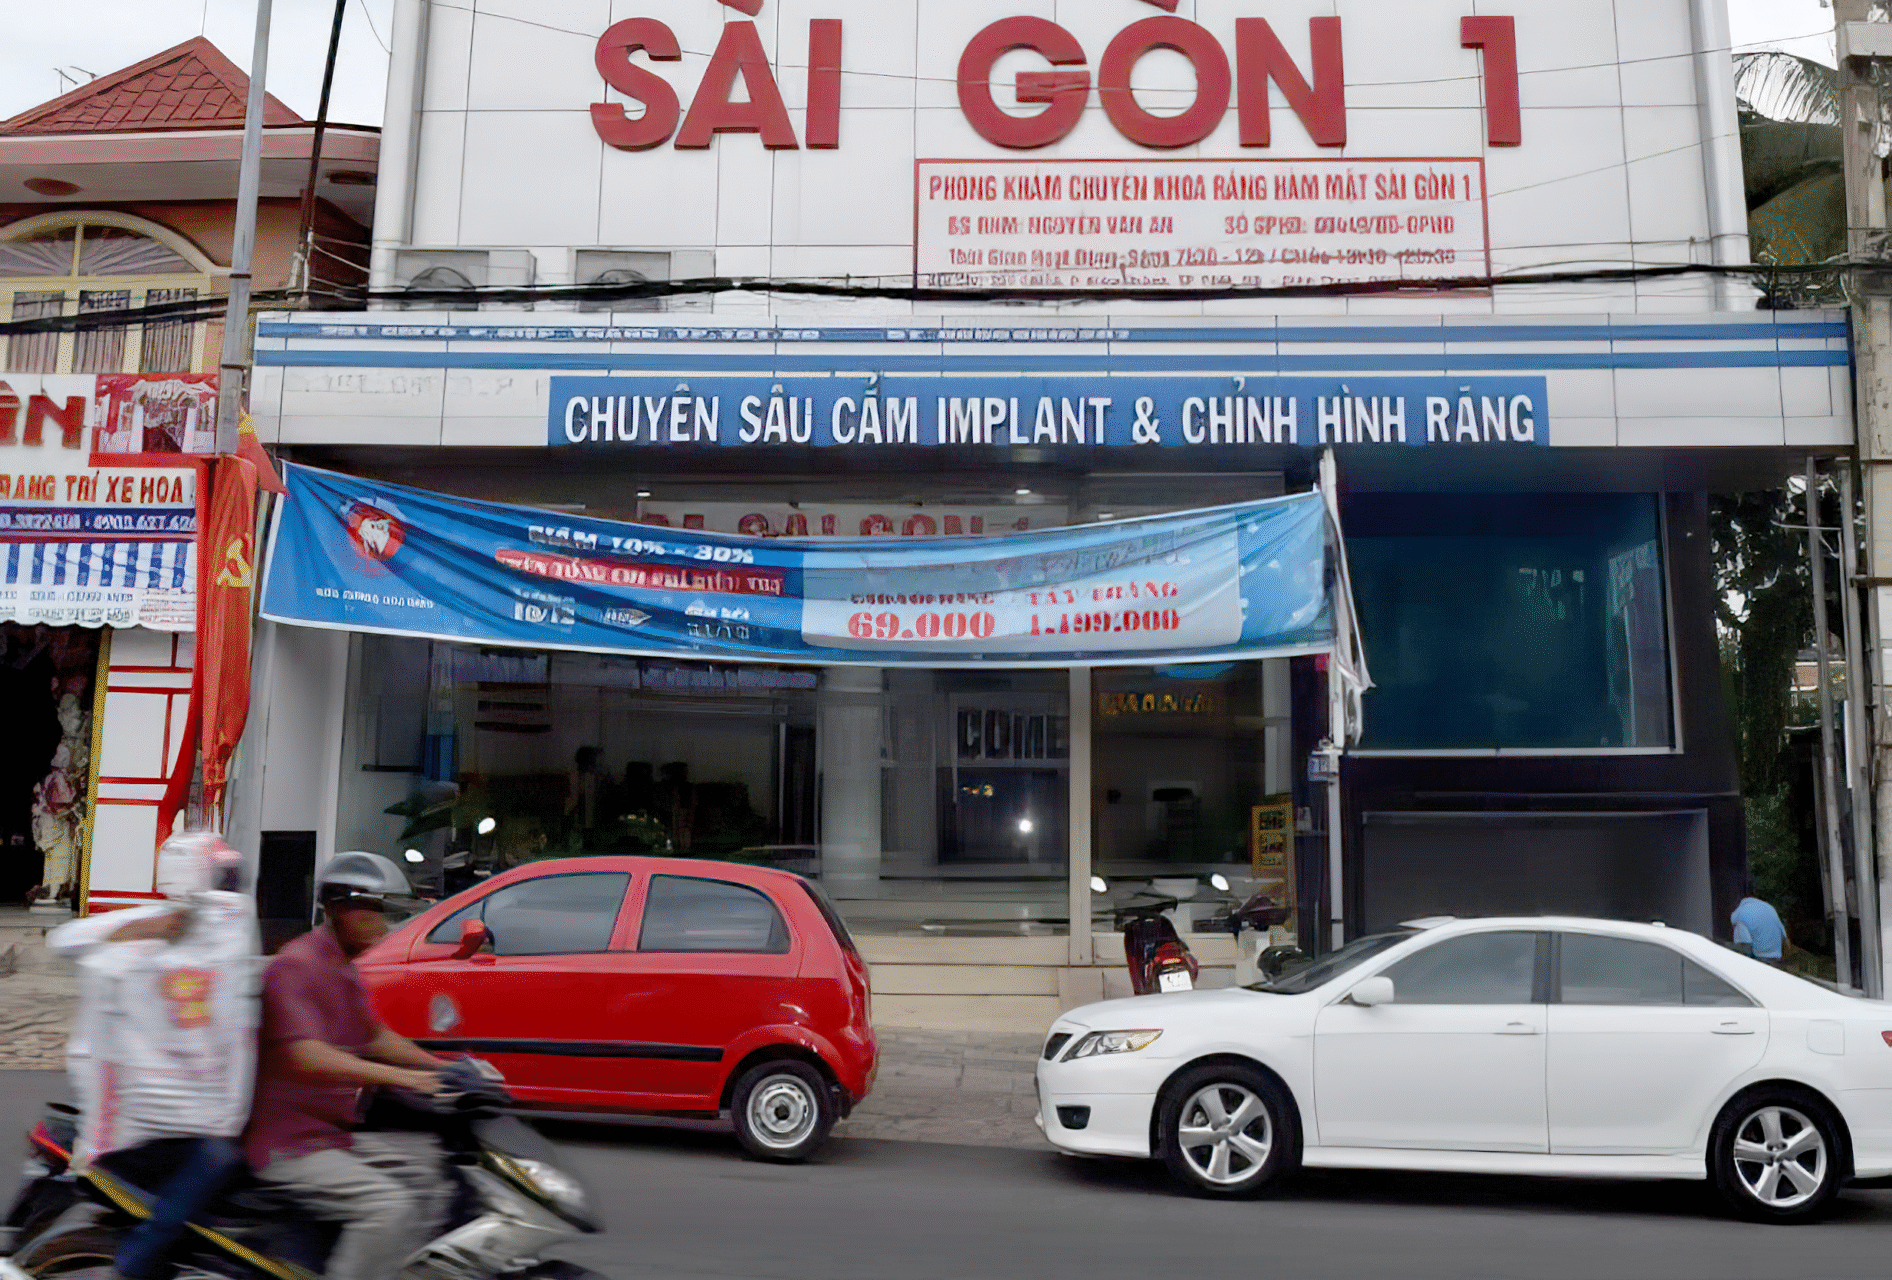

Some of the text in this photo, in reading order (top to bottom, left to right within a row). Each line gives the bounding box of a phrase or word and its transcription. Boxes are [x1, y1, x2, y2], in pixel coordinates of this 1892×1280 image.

[1460, 15, 1523, 149] 1
[1153, 175, 1206, 201] KHOA
[1462, 174, 1471, 201] 1
[566, 384, 719, 442] CHUYÊN
[739, 384, 812, 442] SÂU
[938, 397, 1112, 443] IMPLANT
[1132, 396, 1161, 443] &
[1183, 377, 1297, 443] CHỈNH
[1318, 384, 1406, 443] HÌNH
[1427, 386, 1534, 443] RĂNG
[106, 476, 134, 503] XE
[140, 476, 183, 504] HOA
[847, 611, 996, 639] 69.000
